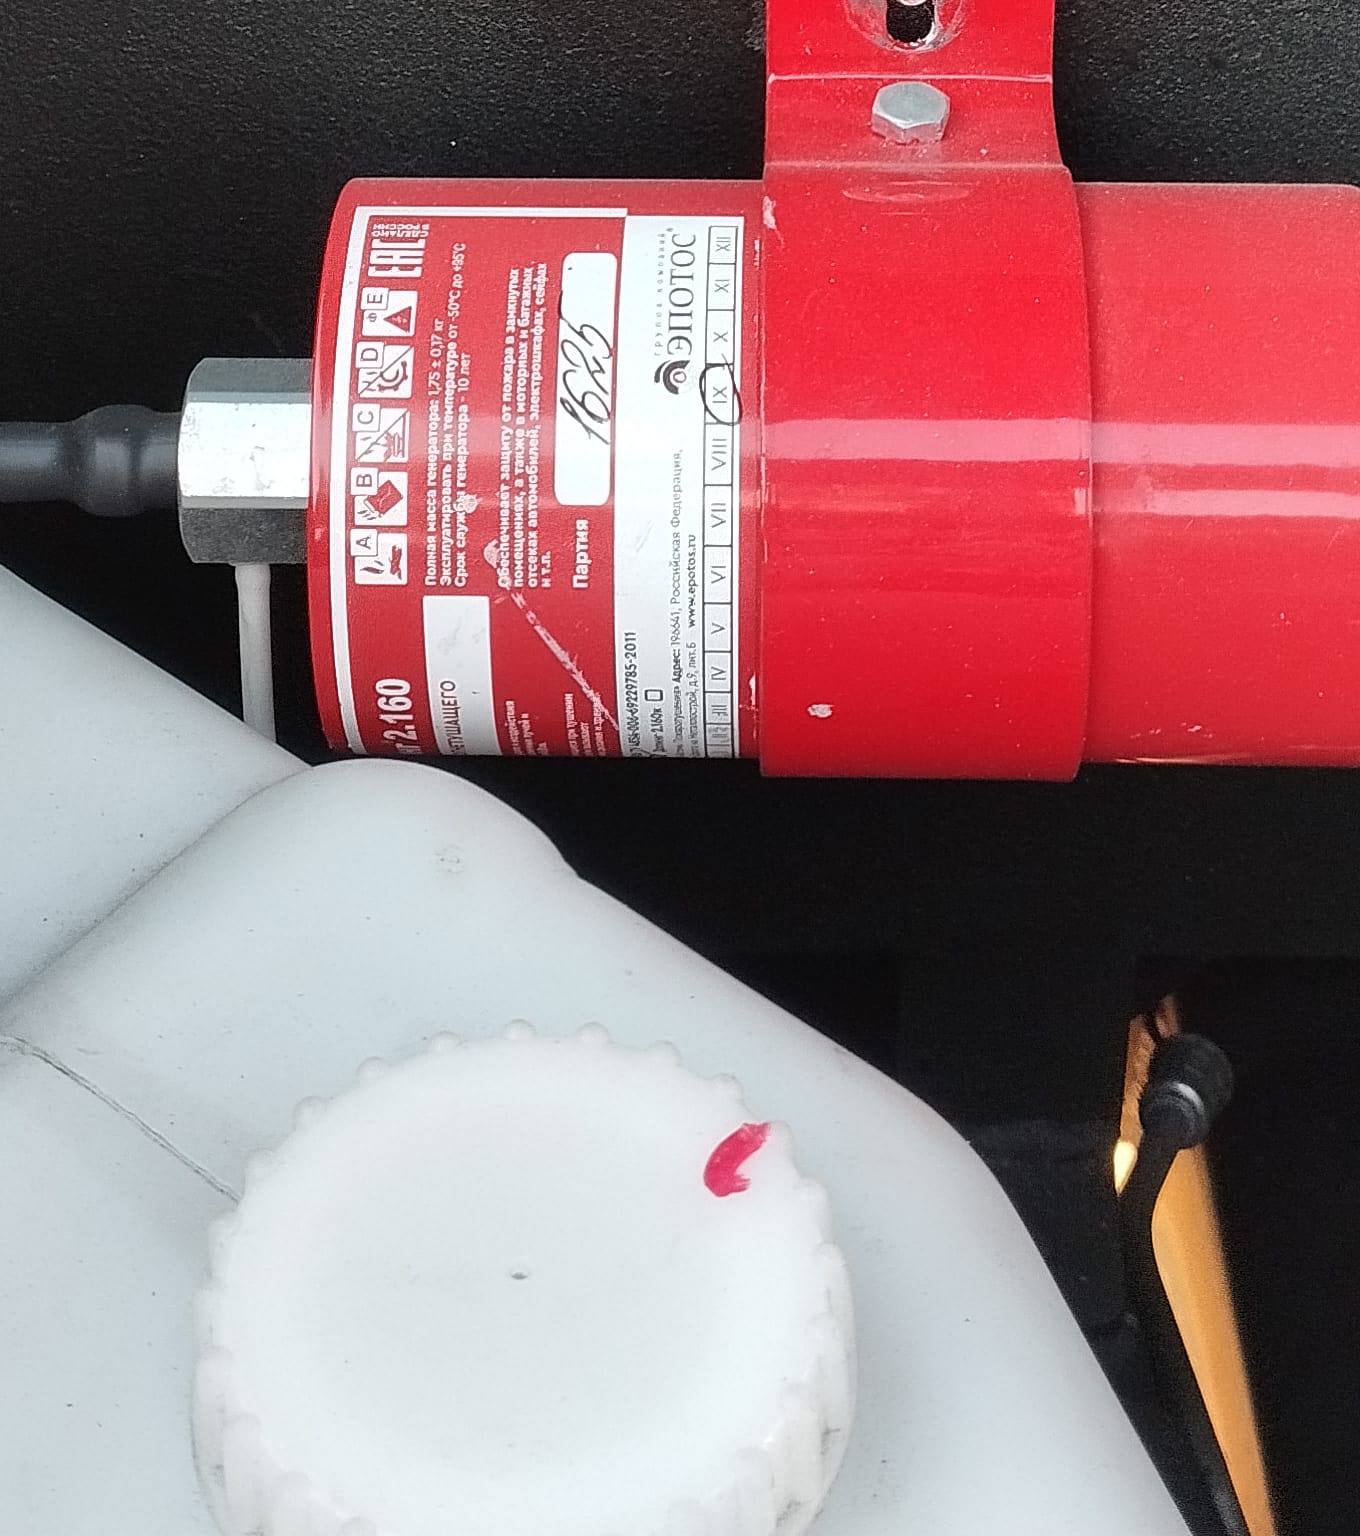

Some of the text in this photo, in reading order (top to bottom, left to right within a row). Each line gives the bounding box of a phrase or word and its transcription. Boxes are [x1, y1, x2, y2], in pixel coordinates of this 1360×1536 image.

[715, 236, 731, 252] XII
[452, 274, 464, 289] до
[517, 267, 534, 327] багажных
[666, 233, 696, 356] ЭПОТОС
[714, 278, 730, 293] XI
[433, 318, 444, 332] кг
[448, 324, 458, 339] от
[713, 331, 728, 343] X
[360, 348, 378, 362] D
[429, 334, 445, 358] 0,17
[460, 352, 471, 375] лет
[516, 342, 530, 413] моторных
[428, 371, 442, 396] 1,75
[443, 342, 458, 431] температуре
[457, 378, 469, 392] 10
[711, 385, 727, 404] IX
[497, 268, 521, 588] Обеспечивает защиту от пожара в замкнутых
[525, 263, 549, 588] отсеках автомобилей, электрошкафах, сейфах
[426, 400, 440, 486] генератора:
[443, 433, 454, 461] при
[456, 404, 470, 488] генератора
[514, 428, 525, 476] также
[711, 438, 727, 471] VIII
[355, 474, 372, 487] B
[515, 479, 524, 488] а
[426, 489, 437, 532] масса
[441, 464, 455, 586] Эксплуатировать
[454, 491, 468, 548] службы
[711, 503, 726, 529] VII
[355, 535, 371, 550] A
[513, 491, 526, 588] помещениях,
[571, 519, 592, 588] Партия
[425, 535, 437, 586] Полная
[455, 551, 468, 587] Срок
[541, 551, 551, 588] и т.п.
[668, 532, 681, 604] Российская
[711, 565, 726, 584] VI
[687, 534, 698, 628] www.epotos.ru
[711, 622, 725, 634] V
[711, 666, 726, 681] IV
[375, 679, 418, 741] 2.160
